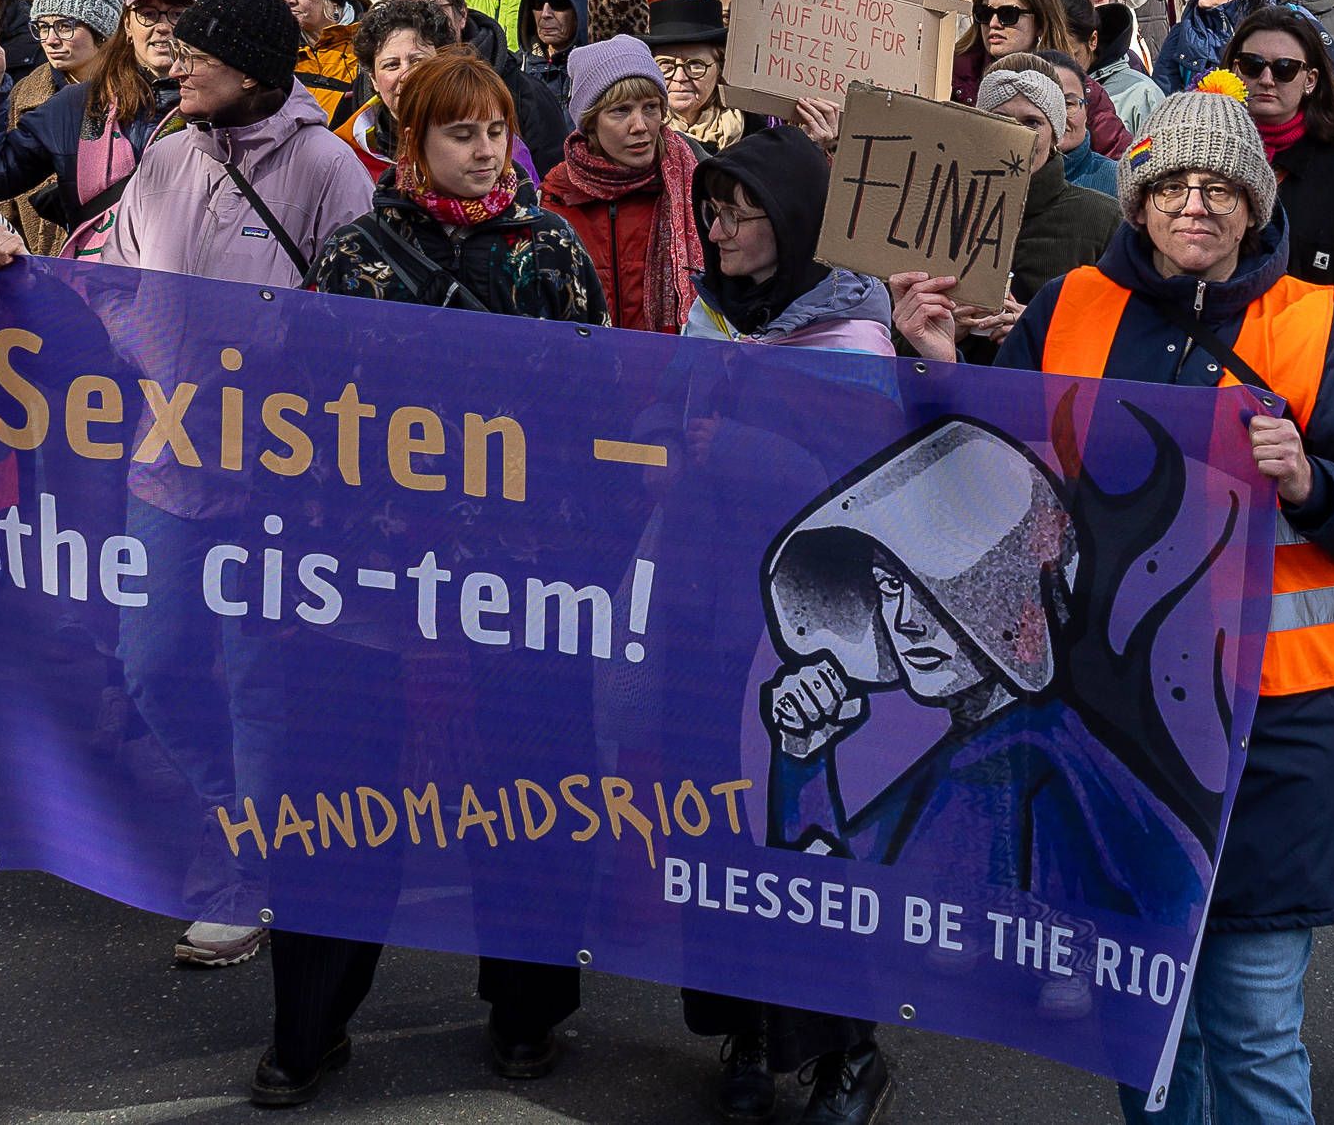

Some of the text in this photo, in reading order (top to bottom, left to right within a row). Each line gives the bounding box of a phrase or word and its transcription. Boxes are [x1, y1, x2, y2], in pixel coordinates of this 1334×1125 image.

[770, 29, 871, 70] HETZE ZU
[771, 2, 906, 56] AUF UNS FÜR
[201, 514, 655, 663] cis-tem!
[217, 775, 753, 869] HANDMAIDSRIOT
[663, 856, 880, 935] BLESSED
[904, 897, 964, 953] BE
[986, 911, 1074, 976] THE
